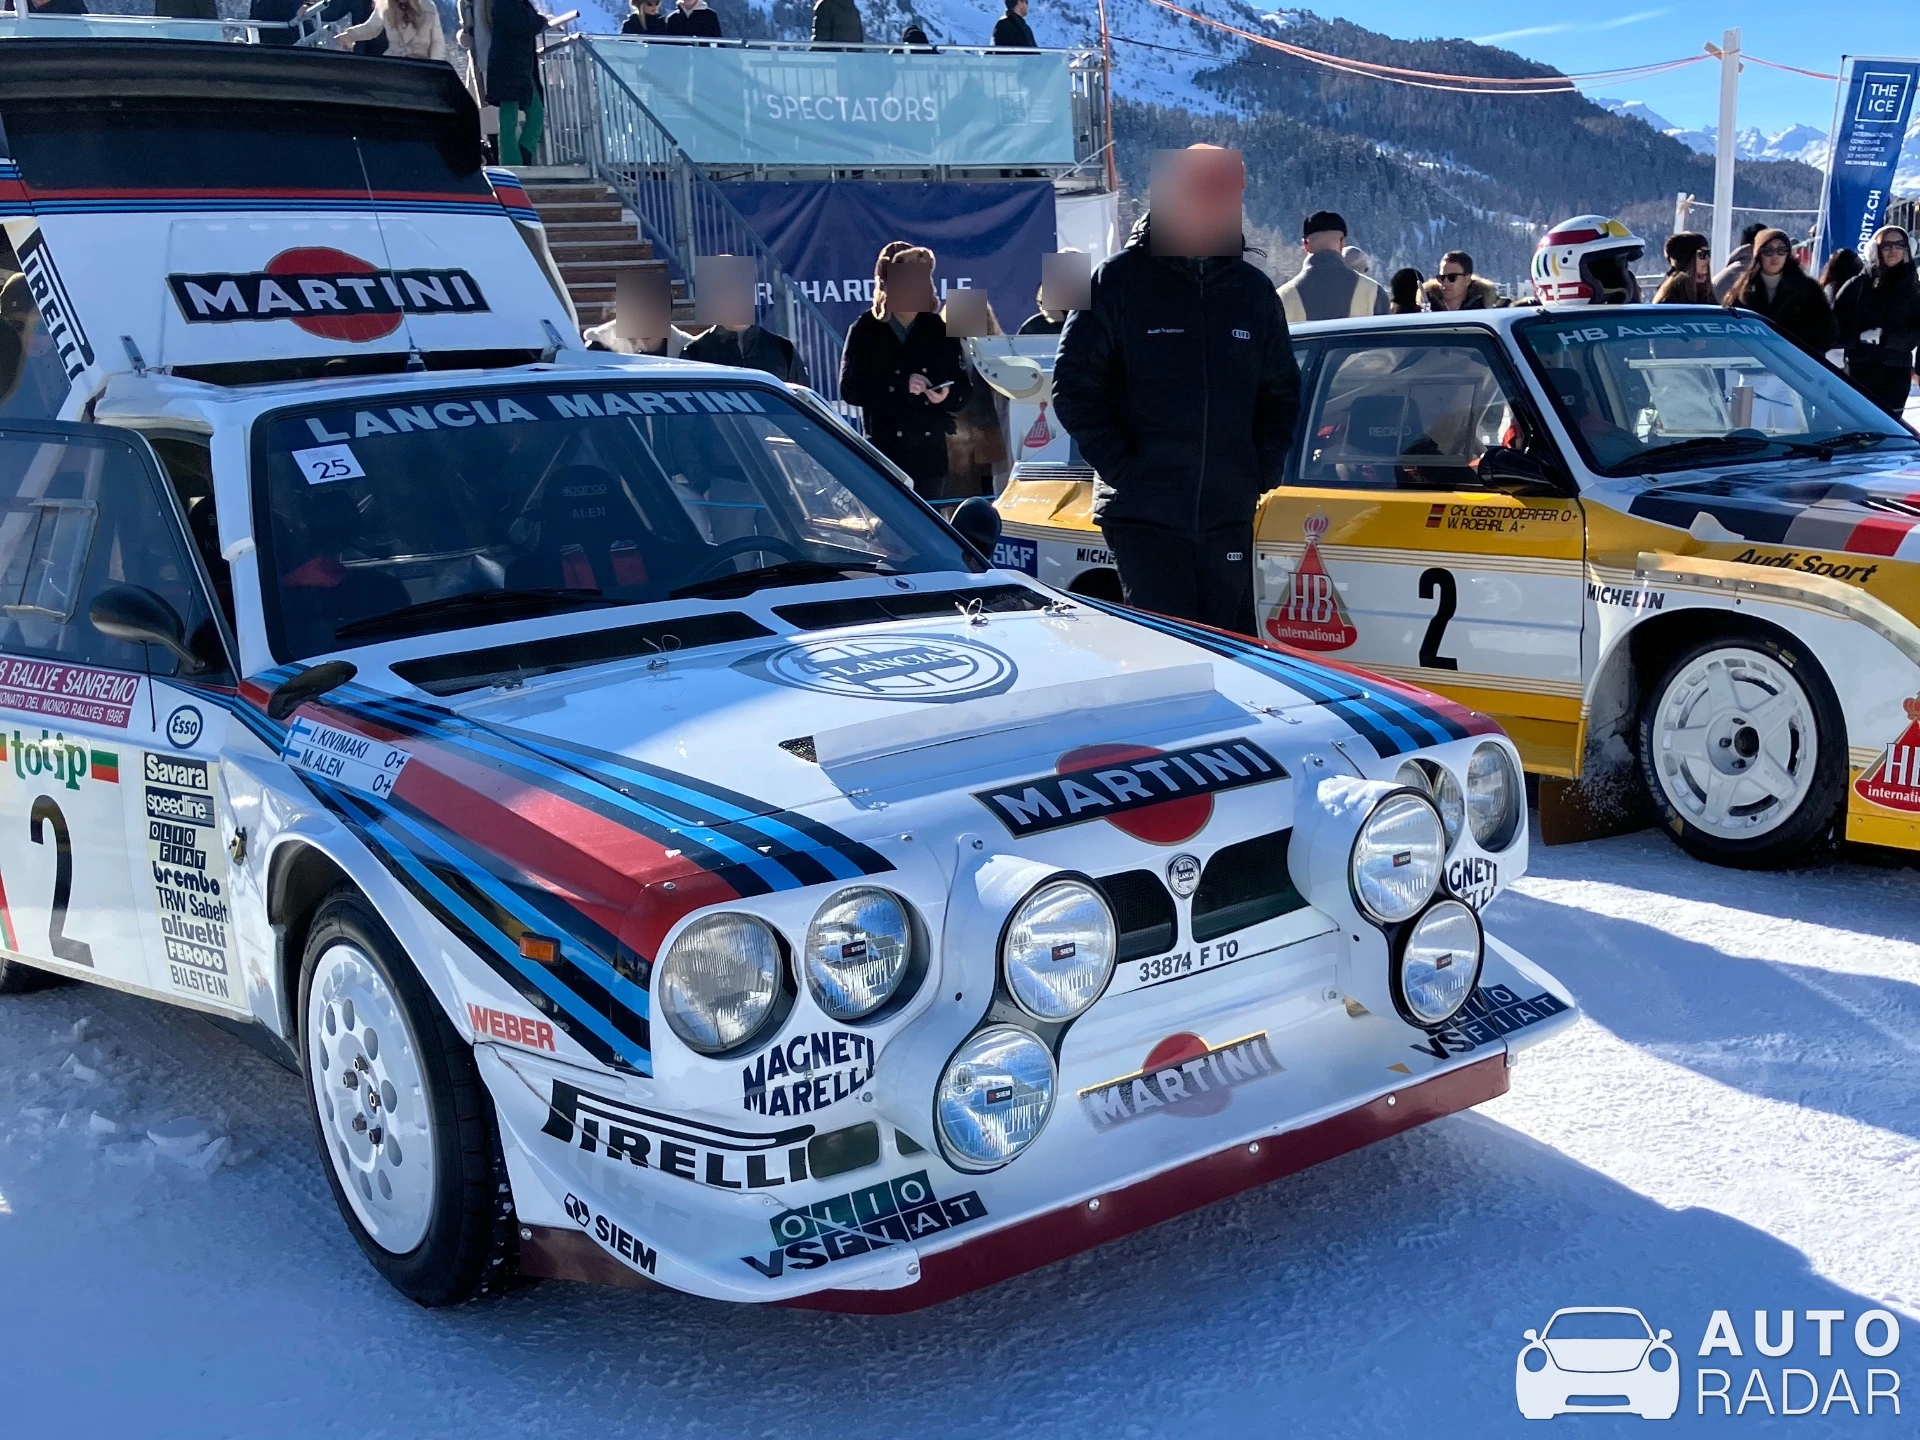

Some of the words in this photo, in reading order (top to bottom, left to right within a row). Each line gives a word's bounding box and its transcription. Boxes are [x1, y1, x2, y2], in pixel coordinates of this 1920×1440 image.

[1868, 99, 1896, 112] ICE
[1870, 83, 1899, 97] THE
[766, 94, 938, 123] SPECTATORS
[1857, 190, 1882, 260] ORITZ.CH
[17, 227, 95, 382] PIRELLI
[184, 275, 475, 314] MARTINI
[755, 279, 876, 305] RHARD
[1557, 328, 1609, 345] HB
[1684, 322, 1769, 337] TEAM
[305, 397, 539, 443] LANCIA
[548, 391, 767, 418] MARTINI
[312, 458, 351, 480] 25
[572, 506, 607, 519] ALEN
[1447, 517, 1459, 529] W.
[1460, 519, 1504, 532] ROEHRL
[1450, 505, 1467, 516] CH.
[1471, 506, 1558, 522] GEISTDOERFER
[993, 543, 1034, 568] SKF
[1077, 548, 1116, 565] MICHE
[1732, 548, 1800, 567] Audi
[1795, 555, 1878, 583] Sport
[1288, 572, 1334, 624] HB
[1587, 583, 1665, 610] MICHELIN
[1277, 624, 1346, 644] international
[1419, 567, 1458, 671] 2
[830, 651, 953, 677] LANCIA
[7, 662, 64, 692] RALLYE
[62, 669, 138, 703] SANREMO
[0, 691, 25, 708] ONATO
[25, 696, 40, 710] DEL
[41, 698, 70, 714] MONDO
[71, 702, 104, 720] RALLYES
[172, 715, 198, 736] Esso
[11, 729, 87, 790] totip
[317, 729, 371, 759] KIVIMAKI
[146, 754, 206, 788] Savara
[301, 748, 312, 768] M.
[313, 753, 346, 777] ALEN
[992, 744, 1272, 826] MARTINI
[1867, 784, 1920, 804] internati
[147, 794, 207, 820] speedline
[151, 824, 194, 845] OLIO
[162, 846, 204, 867] FIAT
[30, 794, 95, 968] 2
[152, 860, 221, 896] brembo
[1449, 857, 1498, 892] GNETI
[156, 886, 186, 914] TRW
[189, 893, 229, 924] Sabelt
[161, 914, 227, 948] olivetti
[167, 940, 224, 970] FERODO
[1139, 951, 1193, 982] 33874
[1200, 946, 1211, 966] F
[1216, 939, 1239, 961] TO
[170, 964, 229, 998] BILSTEIN
[467, 1002, 556, 1053] WEBER
[743, 1032, 875, 1096] MAGNETI
[1089, 1039, 1272, 1126] MARTINI
[541, 1079, 816, 1190] PIRELLI
[780, 1179, 926, 1239] OLIO
[834, 1197, 971, 1255] FIAT
[595, 1214, 658, 1276] SIEM
